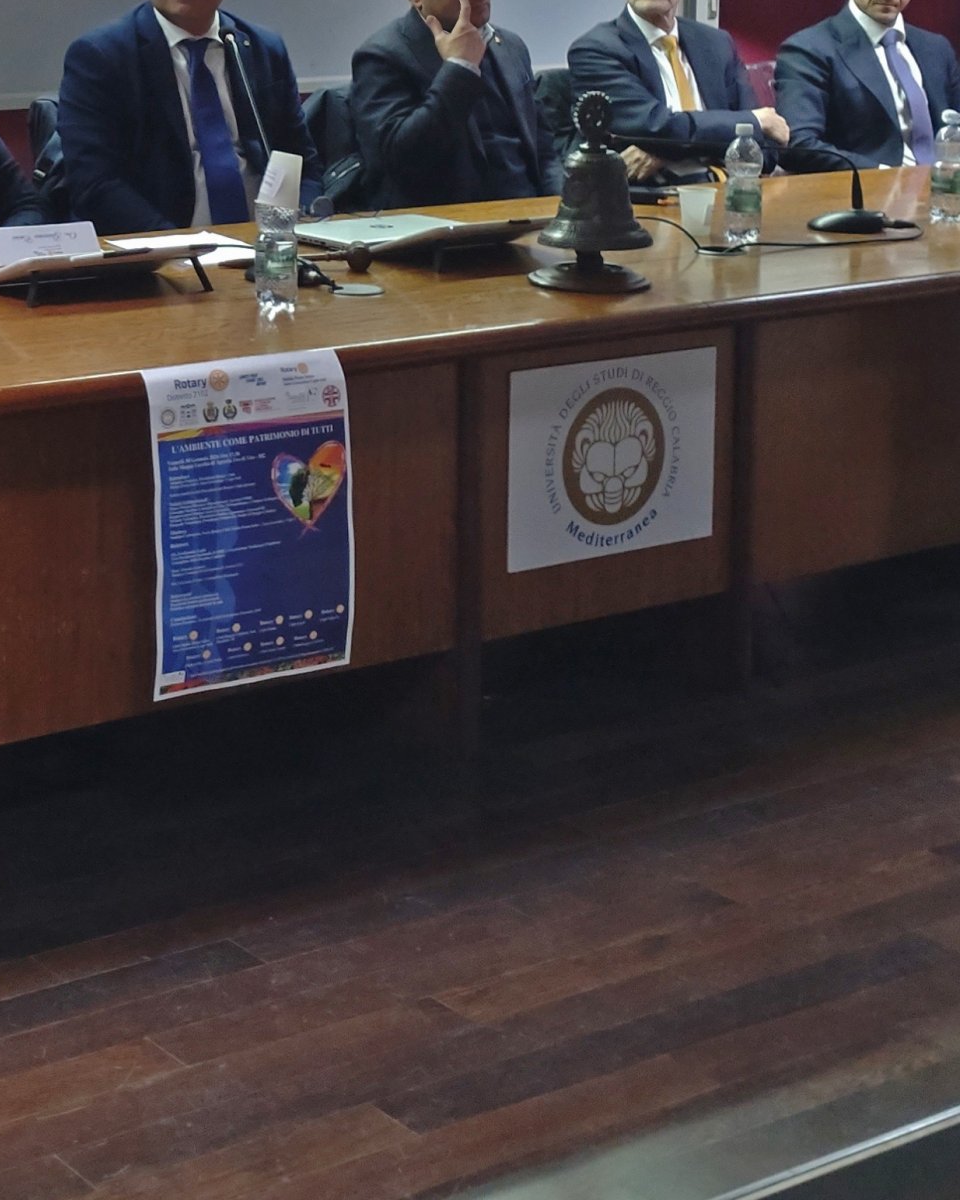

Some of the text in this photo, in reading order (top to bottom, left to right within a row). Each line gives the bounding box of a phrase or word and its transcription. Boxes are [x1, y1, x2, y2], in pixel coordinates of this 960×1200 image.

[174, 377, 207, 390] Rotary
[171, 440, 222, 455] L'AMBIENTE
[223, 436, 248, 448] COME
[248, 431, 300, 444] PATRIMONIO
[311, 424, 334, 435] TUTTI
[558, 379, 591, 419] DEGLI
[592, 366, 628, 385] STUDI
[631, 367, 644, 382] DI
[645, 375, 677, 422] REGGIO
[662, 426, 680, 498] CALABRIA
[565, 508, 659, 547] Mediterranea
